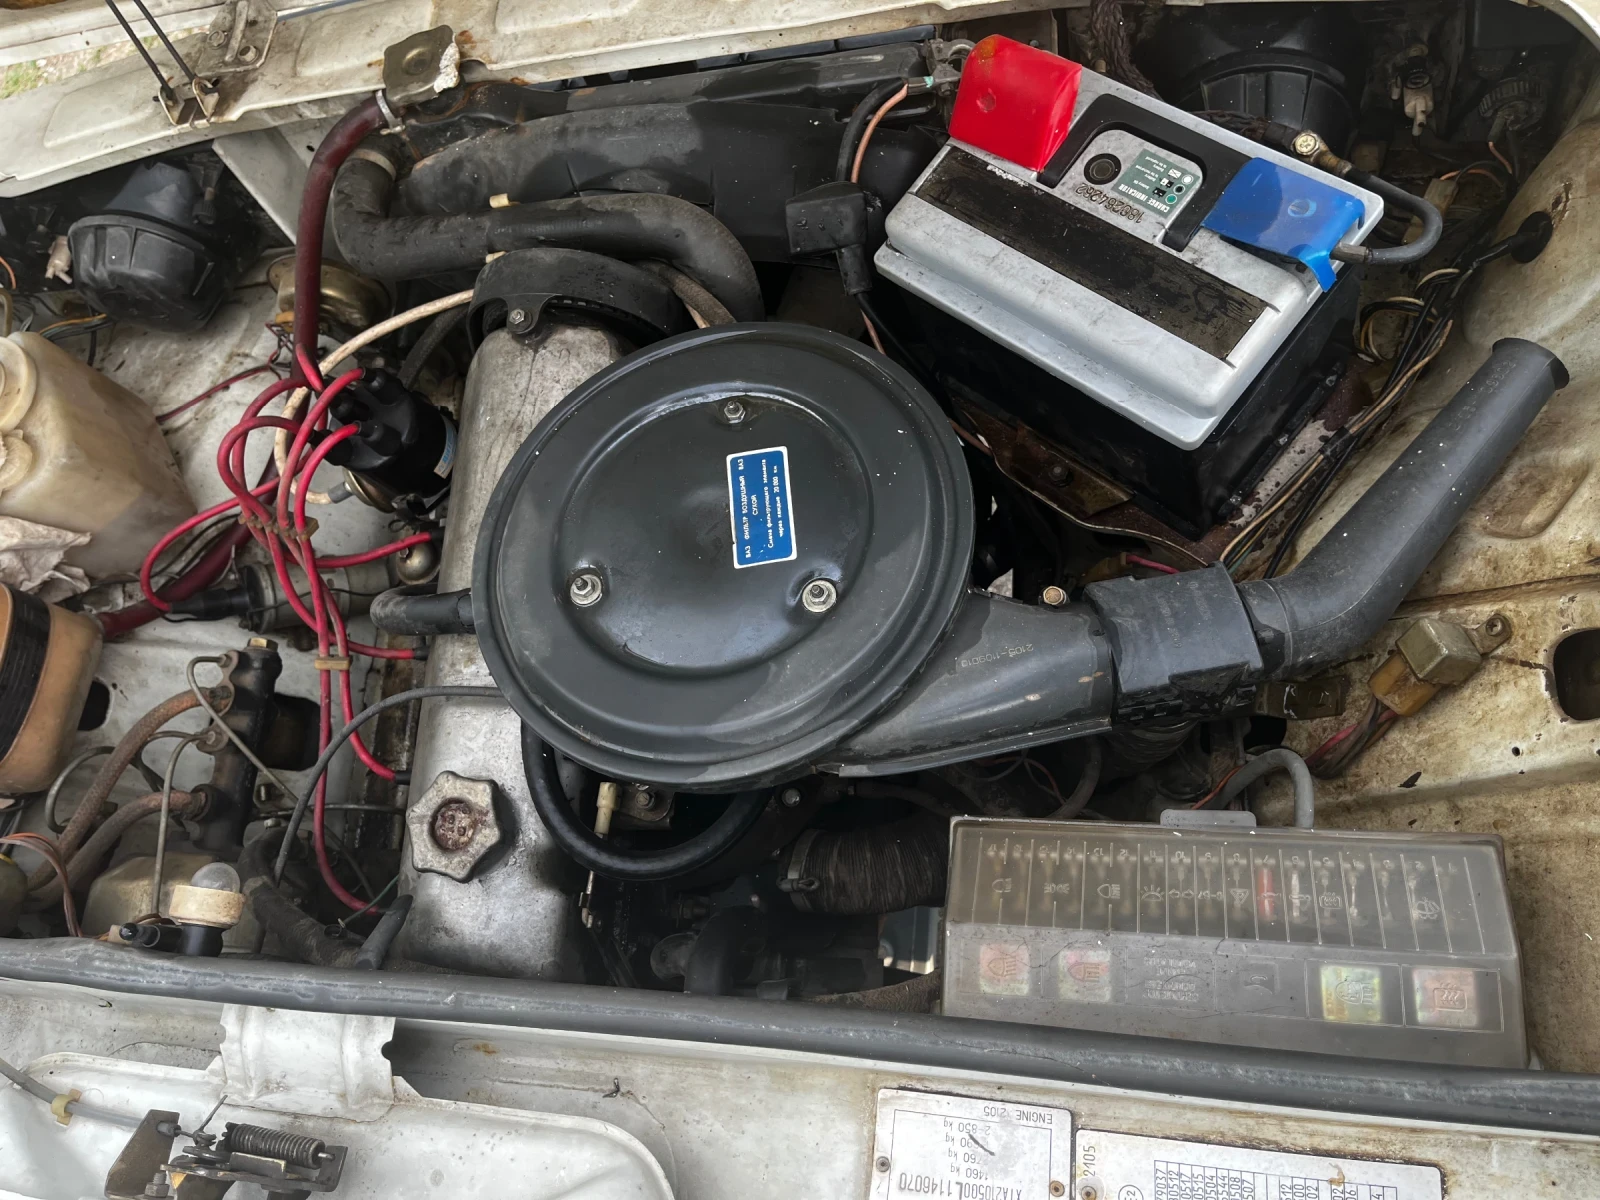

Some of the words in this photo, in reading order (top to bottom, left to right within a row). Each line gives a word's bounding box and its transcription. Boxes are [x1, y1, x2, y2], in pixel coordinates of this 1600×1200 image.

[1118, 183, 1148, 201] INDICATOR
[1150, 198, 1170, 212] CHARGE
[739, 476, 748, 514] ВОЗДУШНЫЙ
[1175, 851, 1185, 859] 10
[984, 1106, 1007, 1117] 2105
[1016, 1109, 1053, 1124] ENGINE
[944, 1117, 952, 1130] kg
[945, 1133, 954, 1146] kg
[948, 1148, 957, 1161] kg
[1083, 1145, 1096, 1176] 2105
[950, 1164, 960, 1176] kg
[966, 1168, 988, 1181] 1460
[1230, 1176, 1241, 1200] 508
